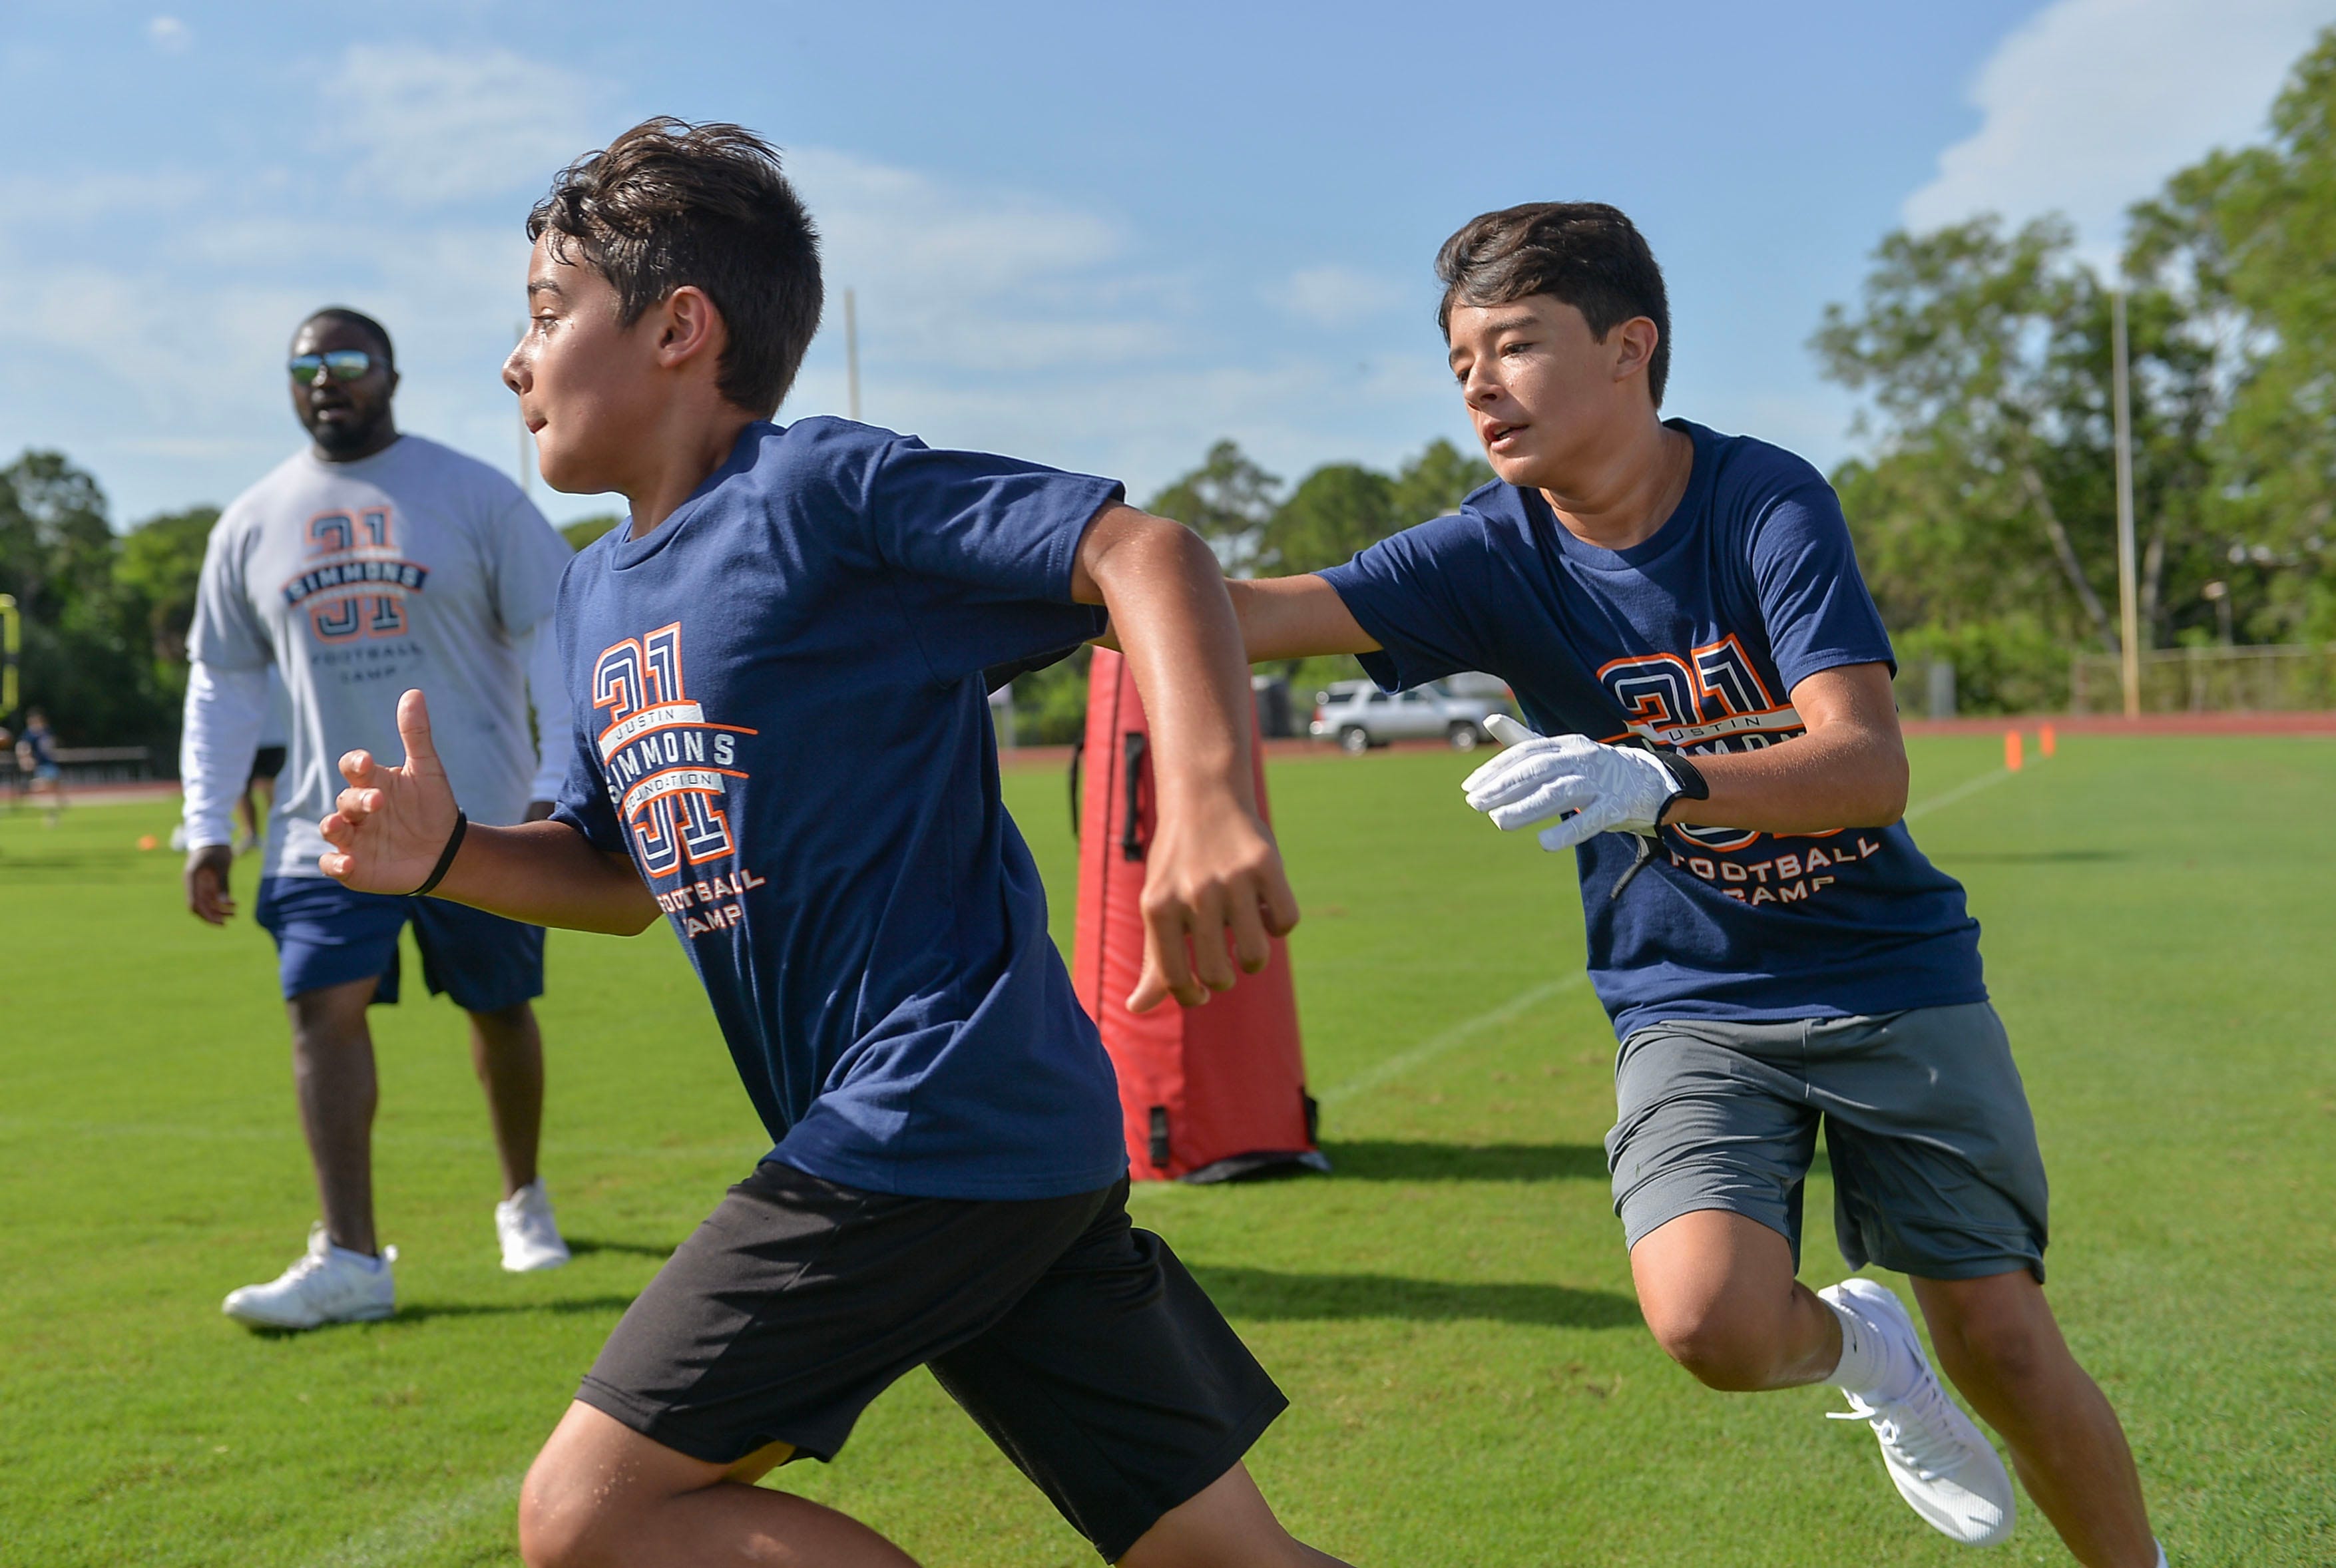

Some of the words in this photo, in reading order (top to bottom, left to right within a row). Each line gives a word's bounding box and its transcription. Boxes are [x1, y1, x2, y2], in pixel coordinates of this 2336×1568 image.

[287, 562, 419, 598] SIMMONS
[616, 709, 674, 740] JUSTIN
[1668, 716, 1761, 741] USTIN
[606, 731, 736, 804] SIMMONS
[655, 869, 767, 914] FOOTBALL
[682, 904, 744, 939] AMP
